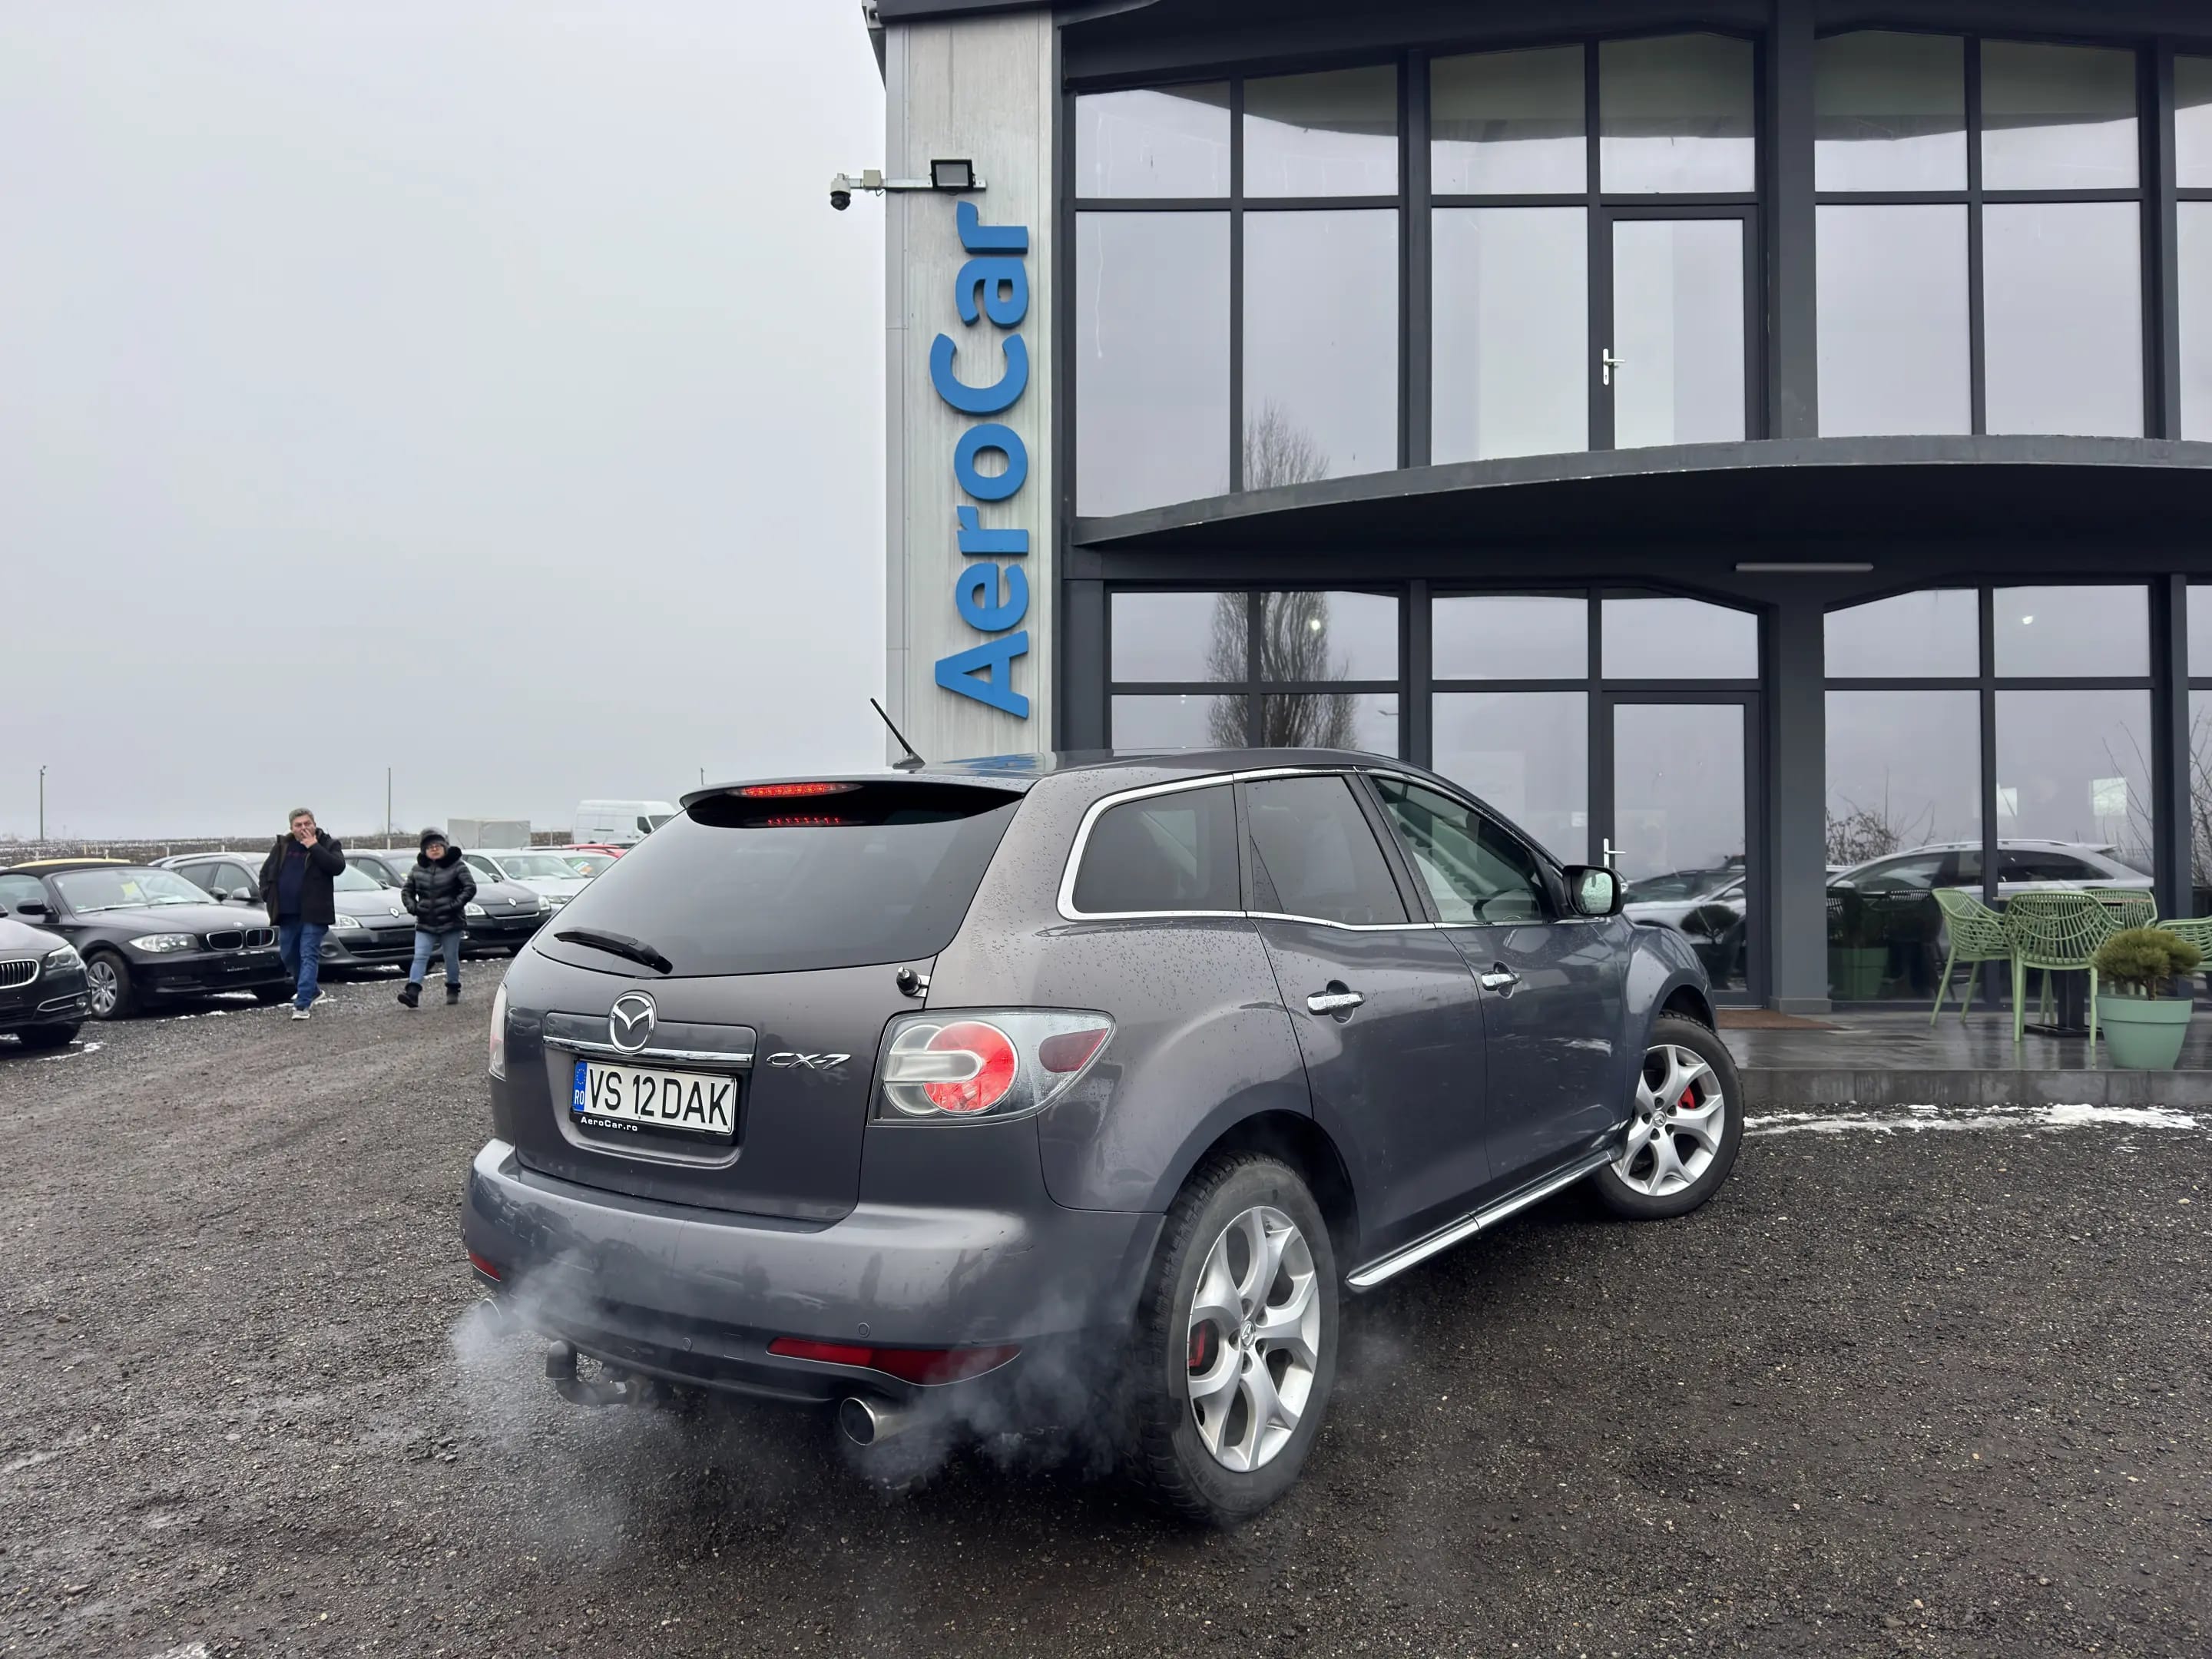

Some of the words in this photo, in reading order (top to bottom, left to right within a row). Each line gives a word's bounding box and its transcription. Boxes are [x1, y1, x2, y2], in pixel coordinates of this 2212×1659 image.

[929, 201, 1029, 720] AeroCar
[767, 1052, 852, 1070] CX-7
[575, 1090, 584, 1104] RO
[589, 1068, 622, 1111] VS
[581, 1116, 638, 1131] AeroCar.ro
